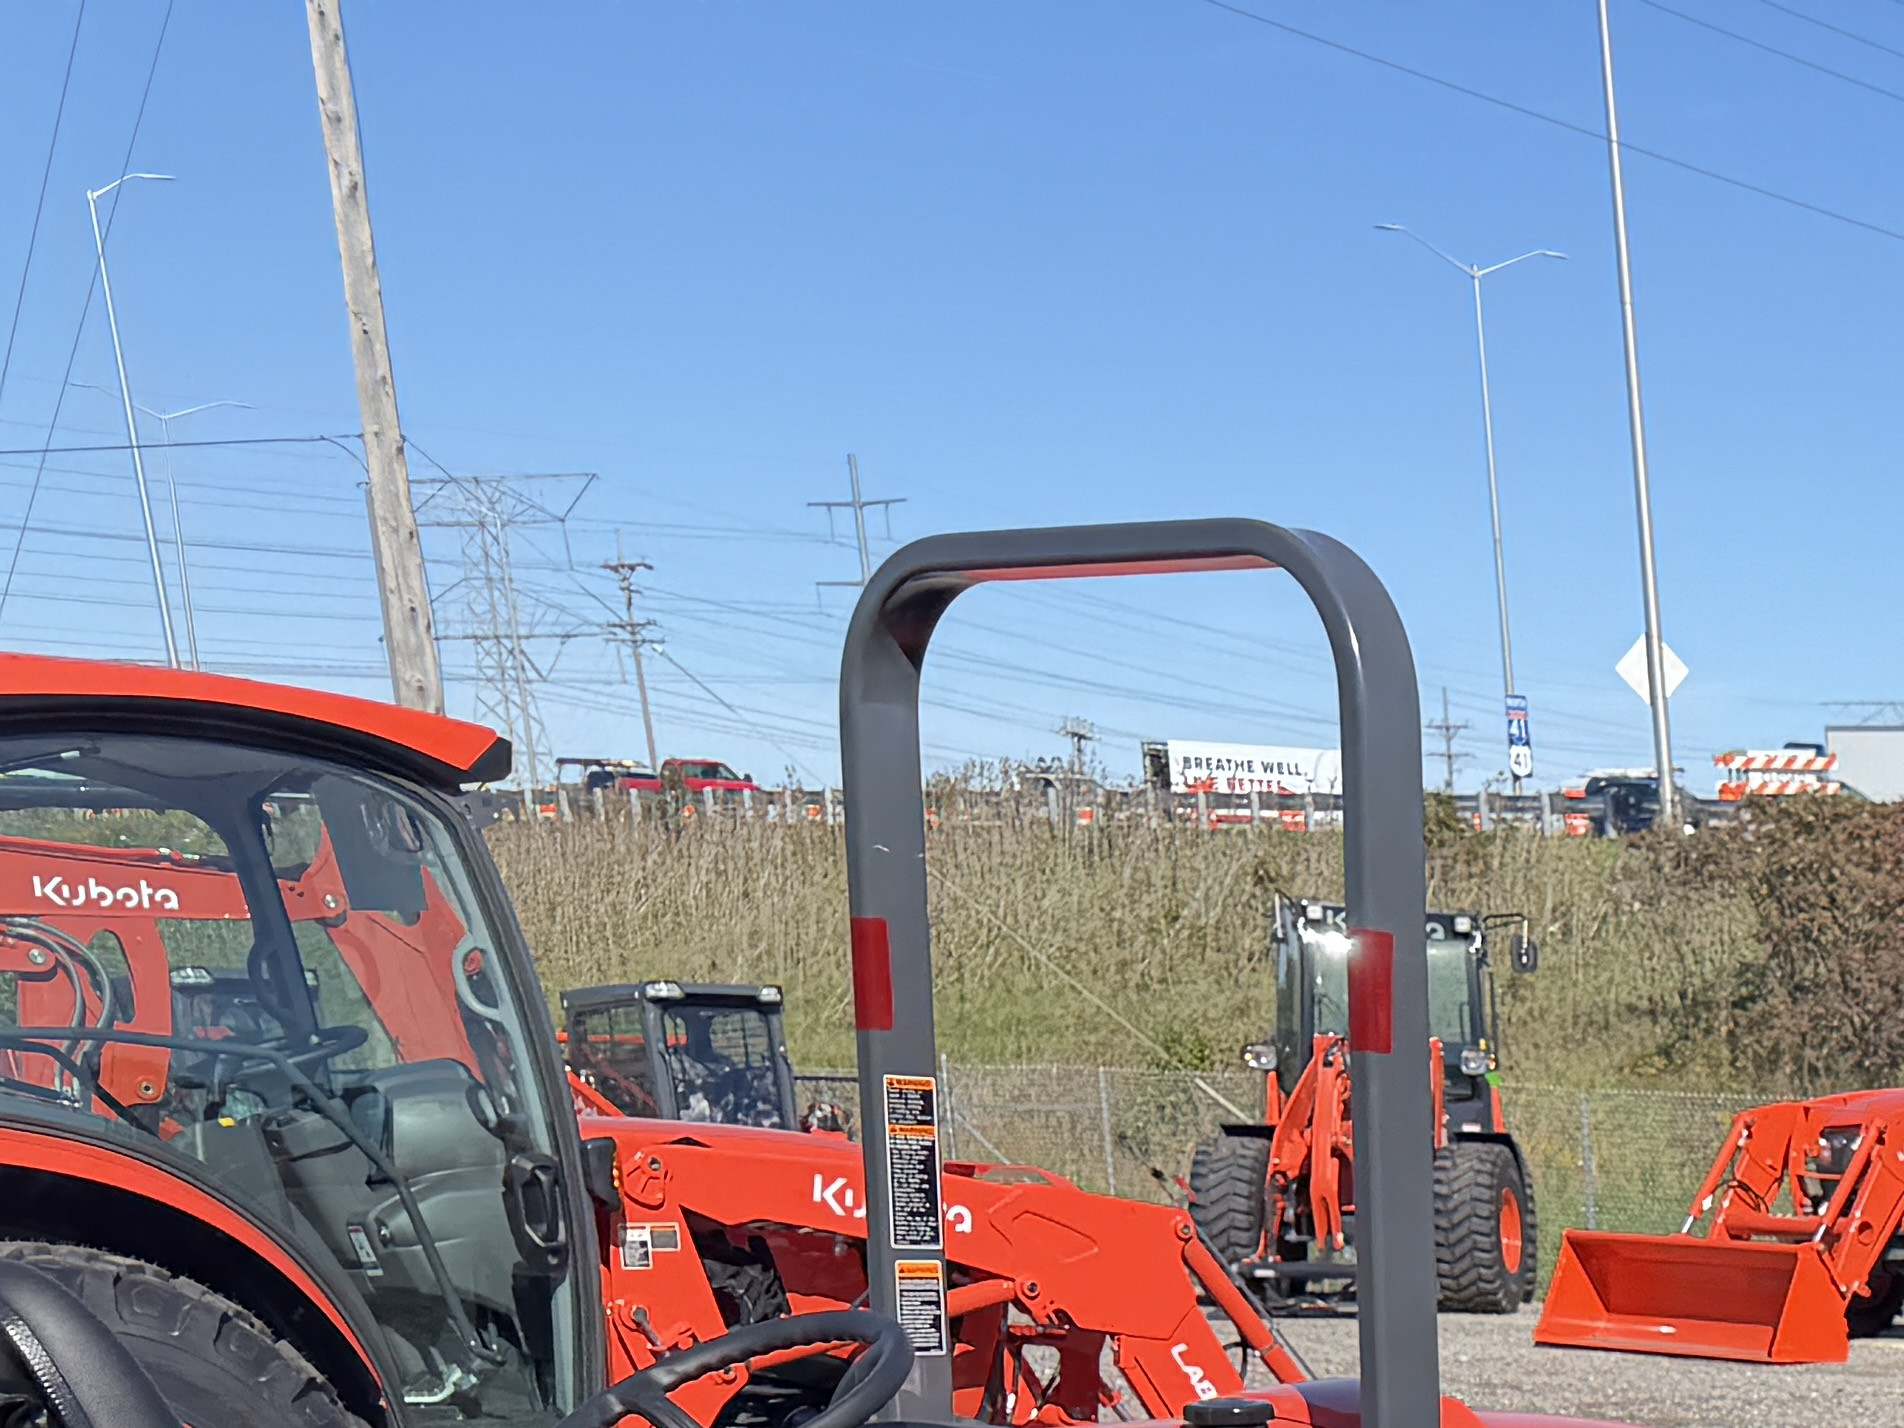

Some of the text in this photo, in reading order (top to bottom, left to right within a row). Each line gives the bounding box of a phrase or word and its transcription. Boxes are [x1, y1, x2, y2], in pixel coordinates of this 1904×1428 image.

[1182, 756, 1255, 774] BREATHE
[32, 875, 180, 910] Kubota
[812, 1173, 973, 1233] Kua
